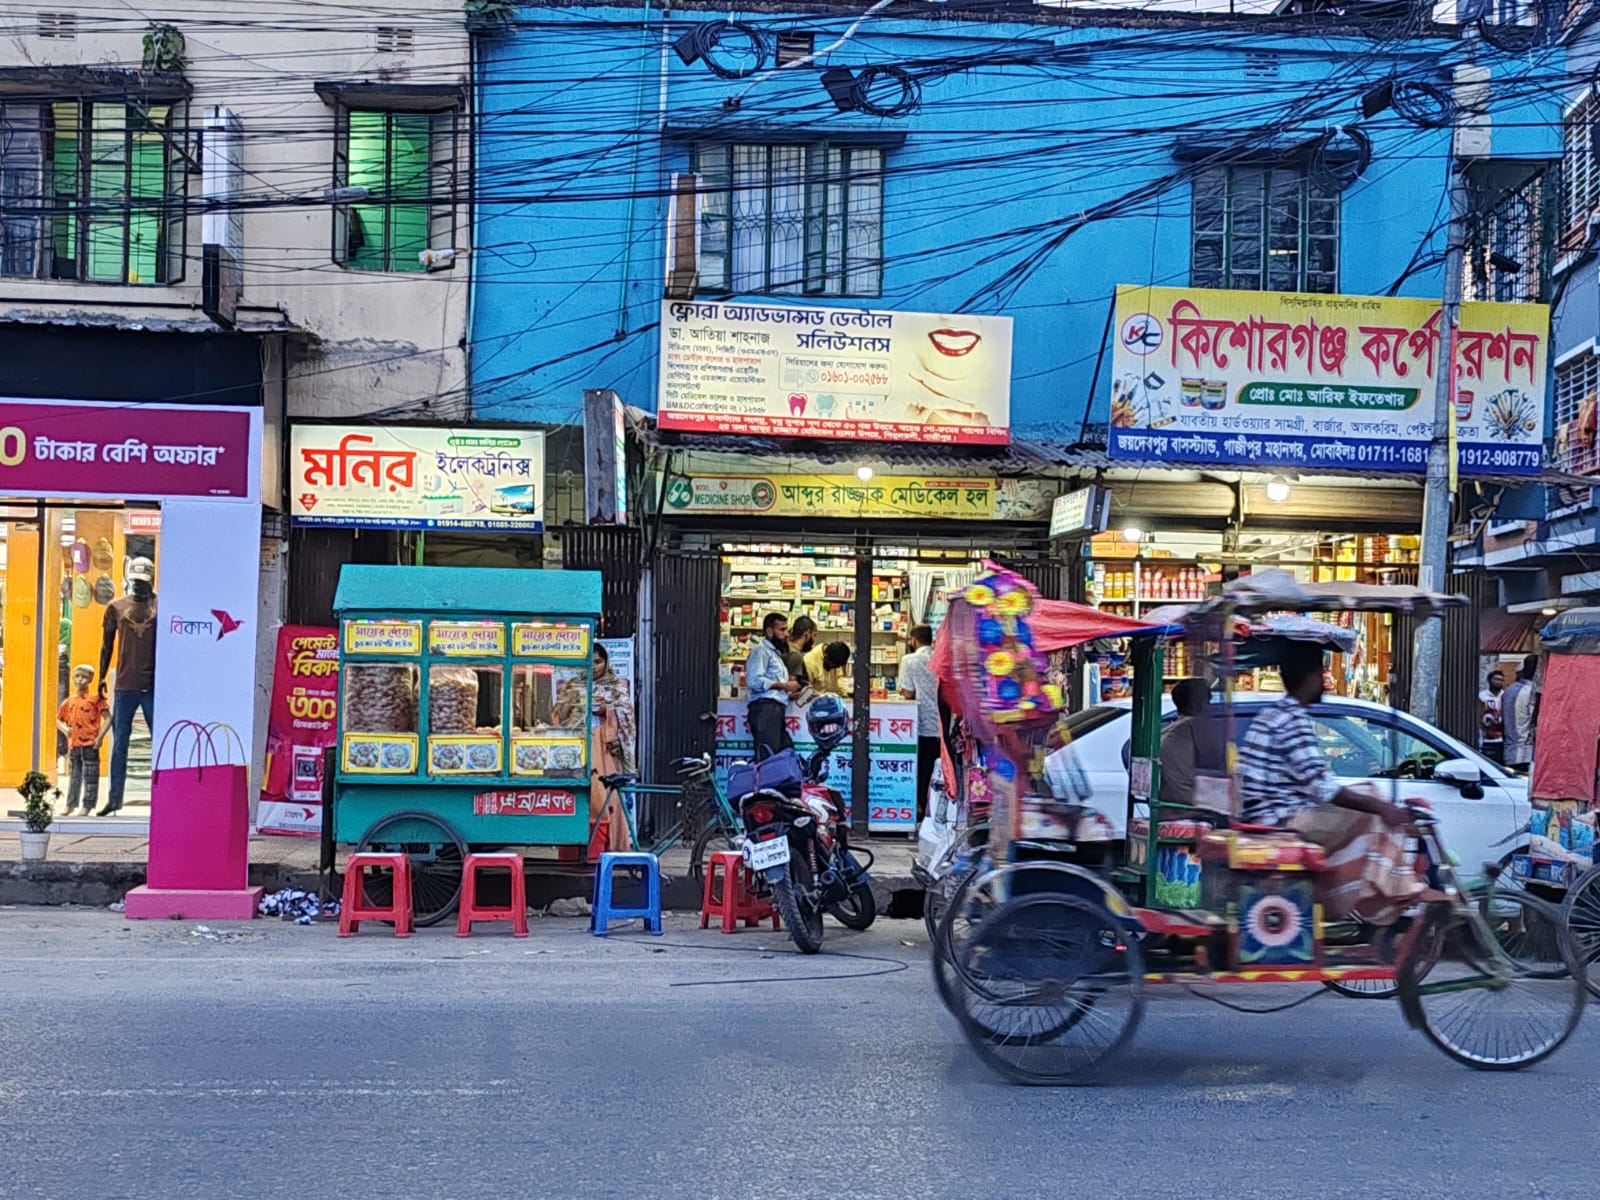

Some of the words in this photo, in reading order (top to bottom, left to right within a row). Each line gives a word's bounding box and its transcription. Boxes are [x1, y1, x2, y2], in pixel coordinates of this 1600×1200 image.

[670, 301, 718, 322] ফ্লোরা
[830, 309, 893, 329] ডেন্টাল
[690, 326, 726, 342] আতিয়া
[730, 330, 770, 345] শাহনাজ
[796, 328, 890, 352] সলিউশনস
[1167, 299, 1347, 377] কিশোরগঞ্জ
[1279, 388, 1303, 404] মোঃ
[1307, 388, 1345, 406] আরিফ
[1348, 388, 1405, 408] ইফতেখার
[1180, 411, 1217, 427] যাবতীয়
[34, 436, 96, 461] টাকার
[102, 439, 148, 463] বেশি
[1117, 434, 1168, 456] জয়দেবপুর
[1224, 434, 1262, 460] গাজীপুর
[1456, 448, 1540, 468] 1912-908779
[301, 434, 417, 492] মনির
[695, 493, 729, 505] MEDICINE
[731, 494, 751, 505] SHOP
[780, 482, 825, 508] আব্দুর
[830, 484, 887, 504] রাজ্জাক
[891, 481, 959, 506] মেডিকেল
[964, 487, 989, 509] হল
[170, 615, 212, 635] বিকাশ
[292, 633, 336, 651] পেমেন্ট
[887, 718, 914, 742] হল
